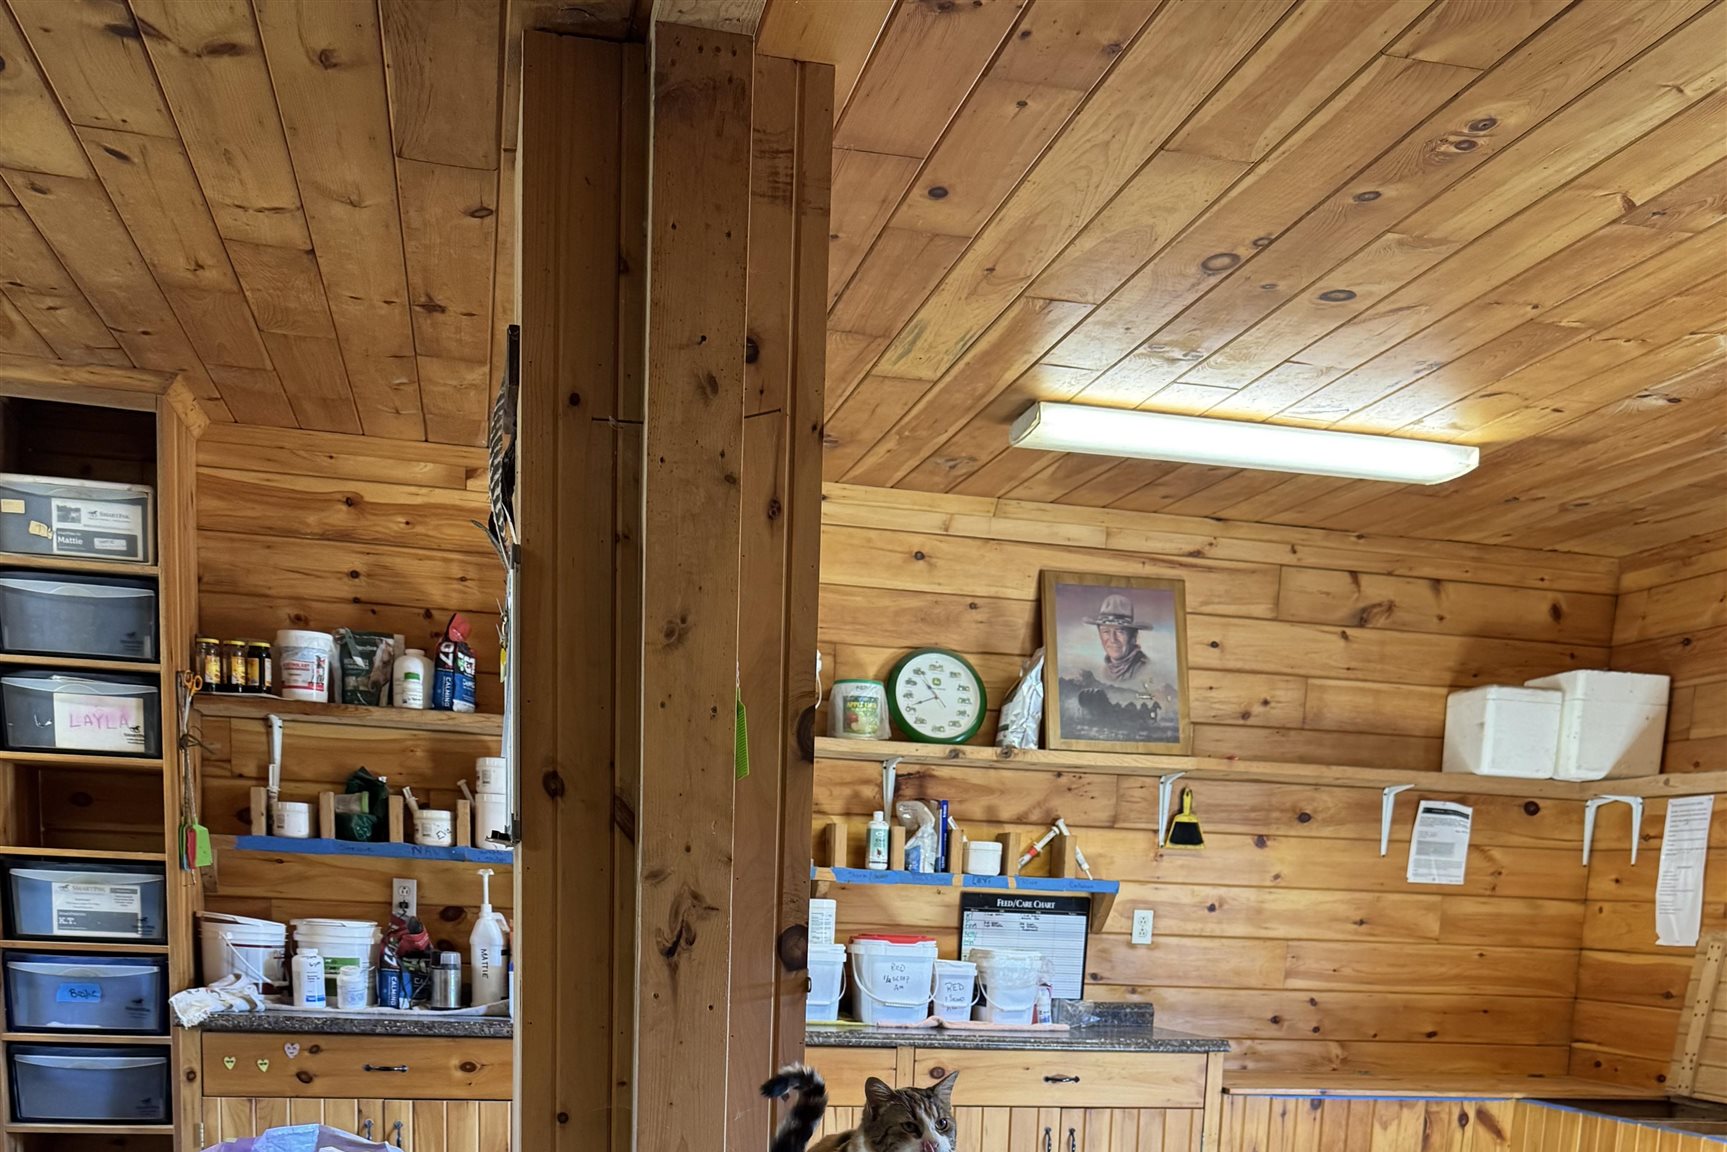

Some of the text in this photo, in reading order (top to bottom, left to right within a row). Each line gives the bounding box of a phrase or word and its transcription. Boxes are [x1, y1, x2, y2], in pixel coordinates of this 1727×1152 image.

[57, 536, 84, 546] Mattie
[444, 677, 452, 708] CALMING
[69, 712, 130, 730] LAYLA
[1033, 899, 1056, 910] CHART
[480, 948, 489, 979] MATTIE
[390, 976, 398, 1006] CALMING
[944, 982, 965, 993] RED
